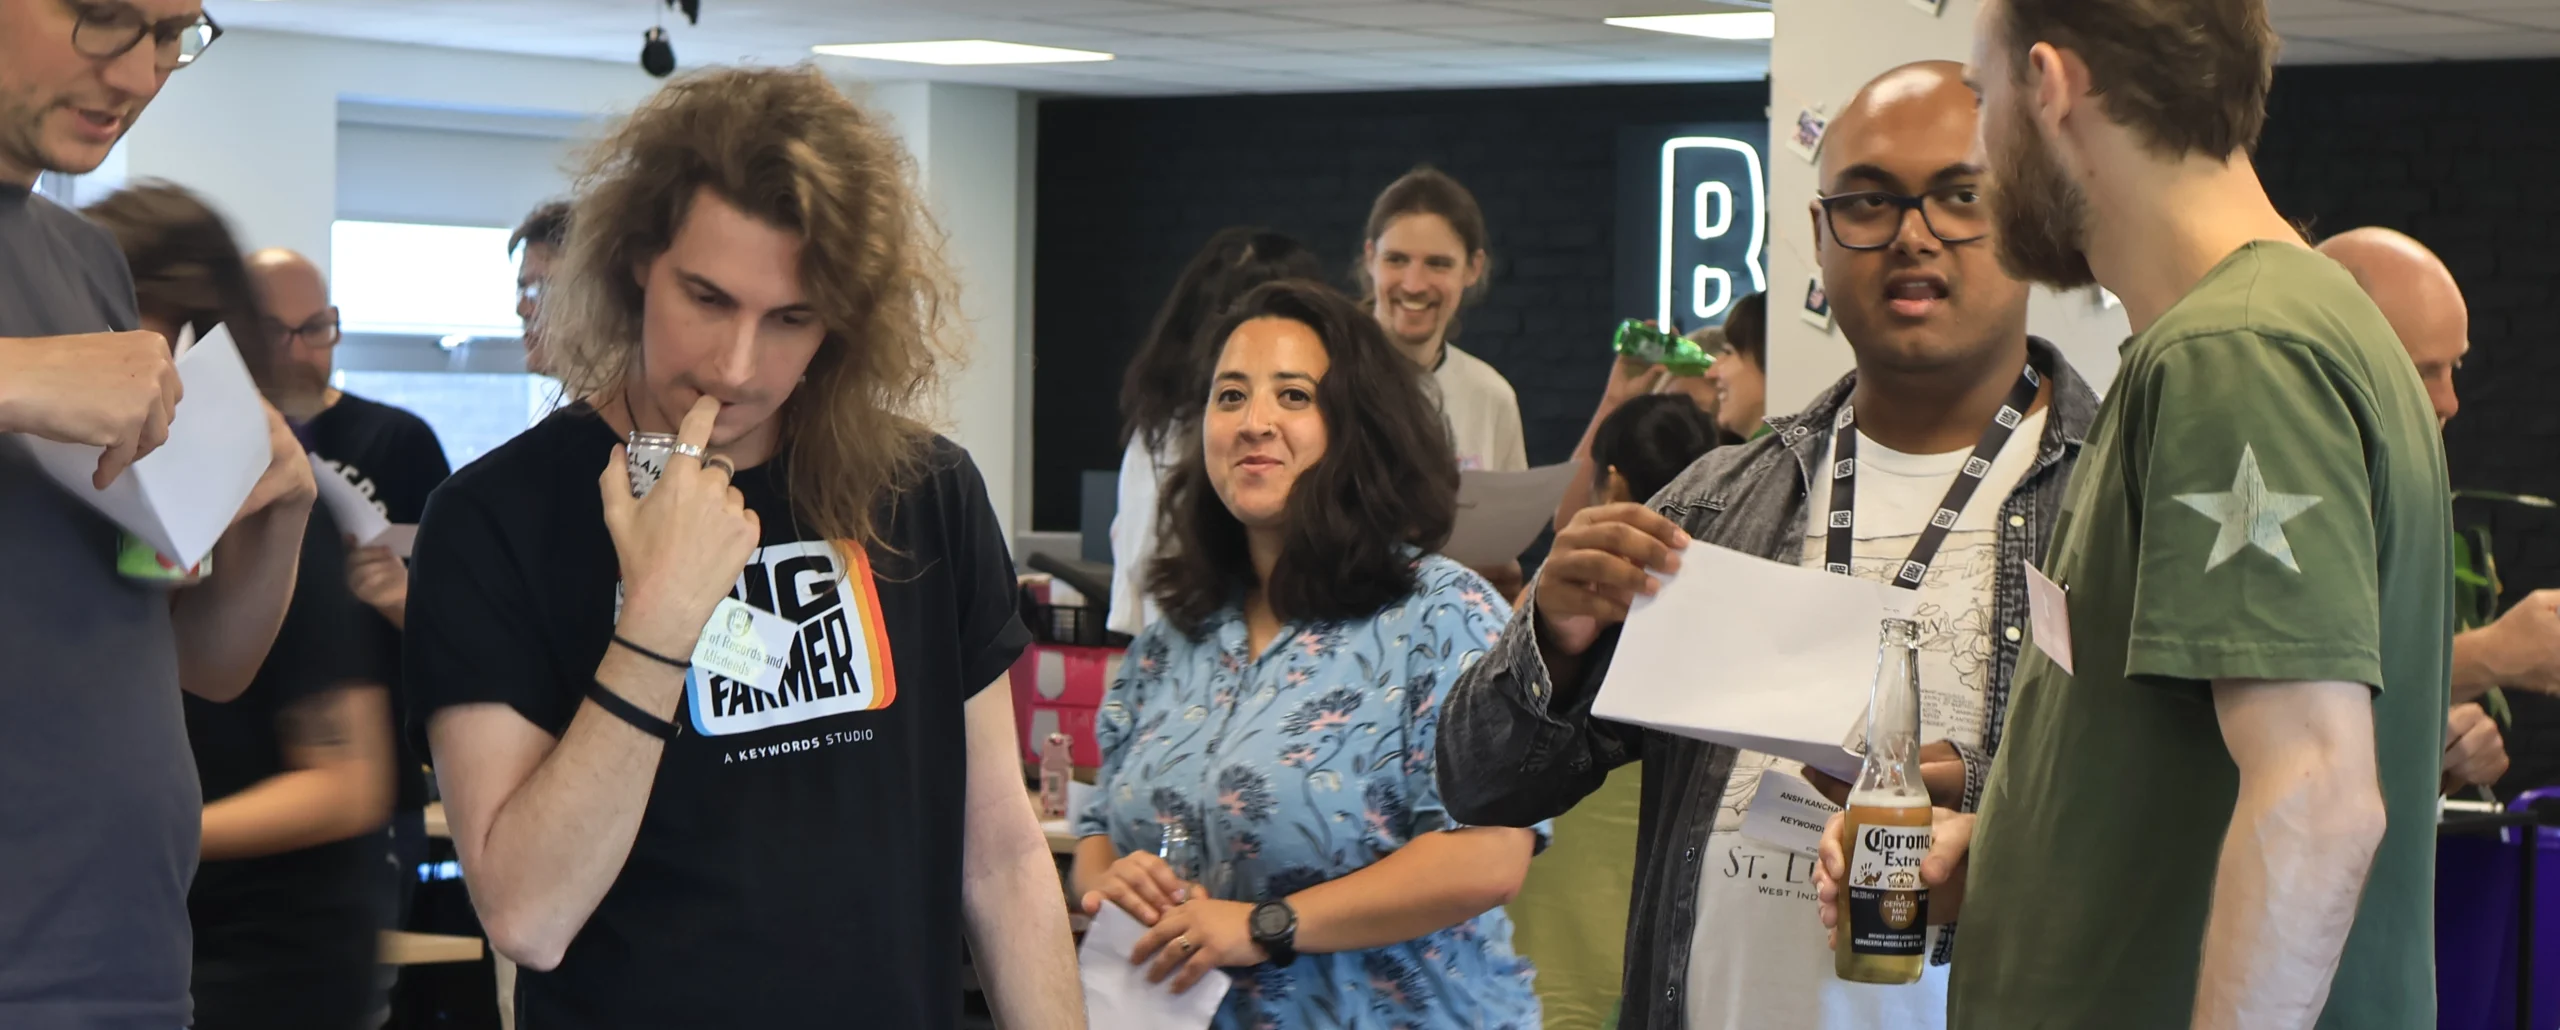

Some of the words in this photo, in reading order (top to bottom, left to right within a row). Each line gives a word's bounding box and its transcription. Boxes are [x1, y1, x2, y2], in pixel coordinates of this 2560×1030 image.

[728, 555, 841, 625] IG
[703, 648, 752, 676] Misdeeds
[709, 633, 721, 645] of
[722, 635, 761, 661] Records
[764, 654, 784, 669] and
[724, 752, 733, 764] A
[738, 737, 820, 762] KEYWORDS
[825, 729, 874, 746] STUDIO
[1780, 792, 1804, 804] ANSH
[1865, 827, 1931, 856] Corona
[1885, 851, 1920, 867] Extra
[1758, 885, 1791, 897] WEST
[1883, 900, 1915, 908] CERVEZA
[1891, 914, 1907, 922] FINA
